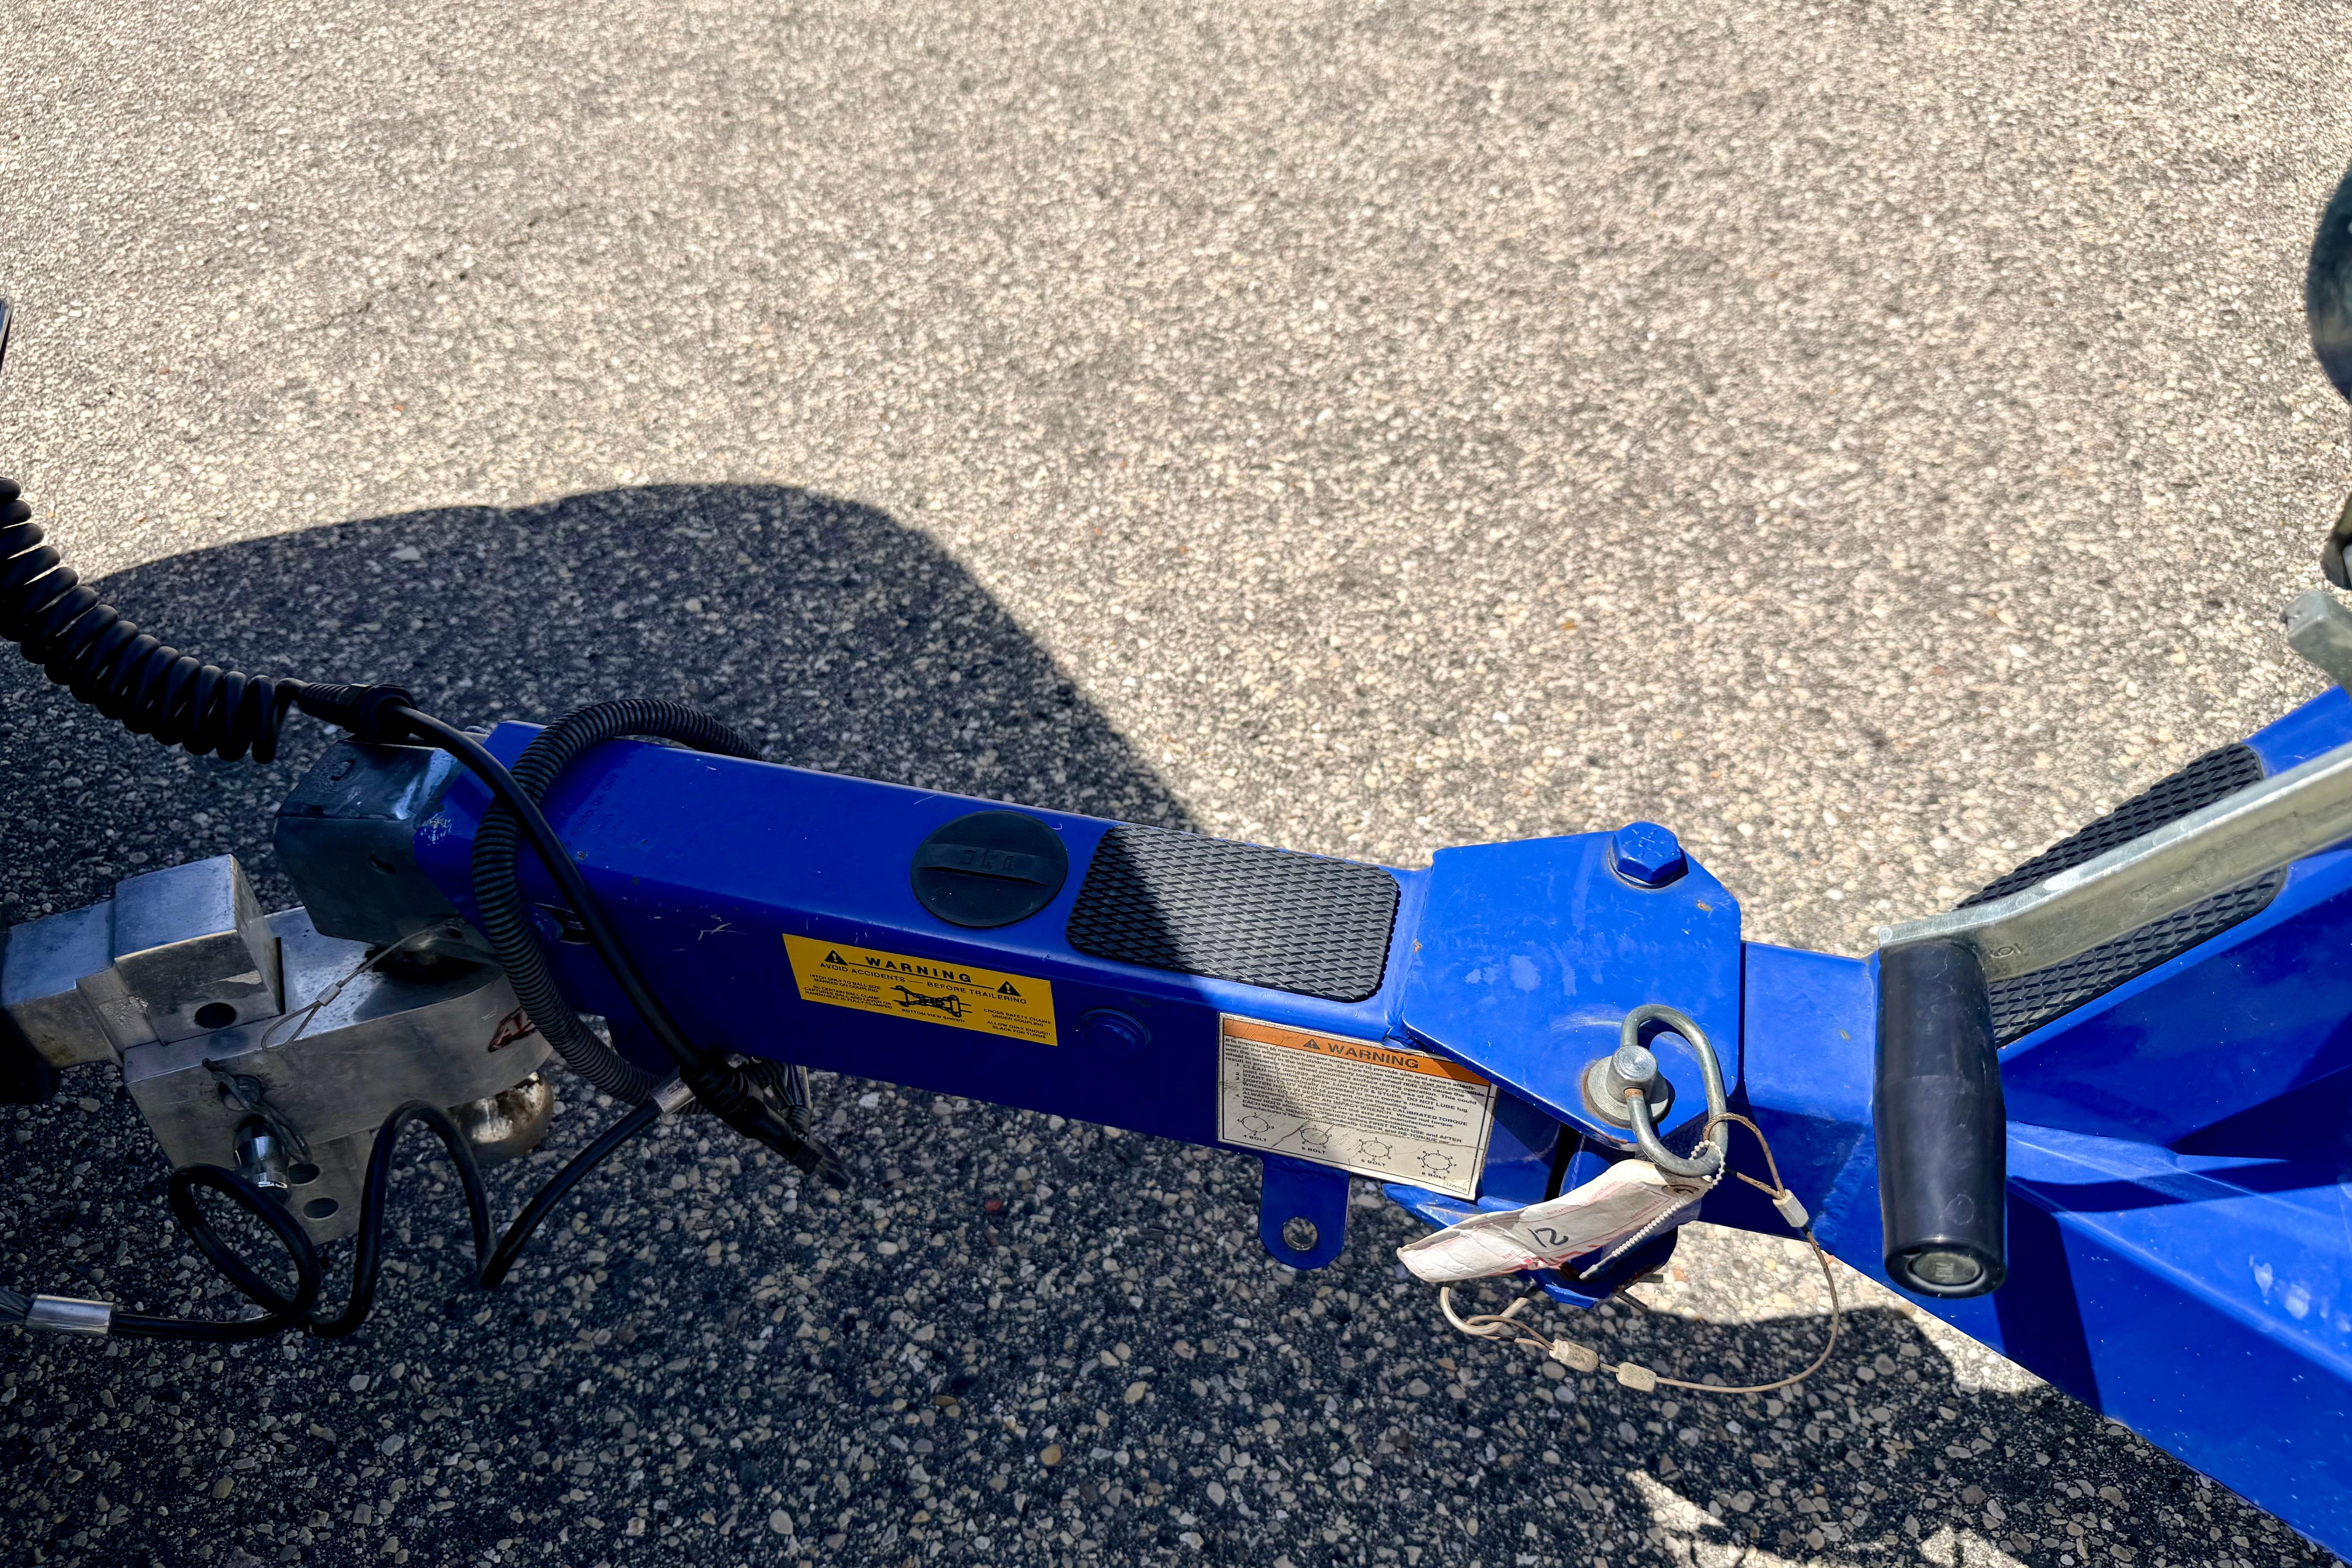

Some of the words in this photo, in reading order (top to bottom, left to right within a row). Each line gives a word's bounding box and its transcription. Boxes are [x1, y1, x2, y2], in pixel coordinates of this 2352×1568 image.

[864, 956, 971, 983] WARNING
[819, 962, 848, 972] AVOID
[850, 968, 905, 982] ACCIDENTS
[926, 981, 966, 993] BEFORE
[969, 989, 1027, 1004] TRAILERING
[1014, 1018, 1043, 1027] COUPLING
[1327, 1043, 1419, 1069] WARNING
[1374, 1067, 1398, 1075] provide
[1377, 1091, 1403, 1099] STUDS.
[1409, 1102, 1435, 1110] manual.
[1392, 1107, 1437, 1120] CALIBRATED
[1438, 1117, 1467, 1126] TORQUE
[1390, 1116, 1436, 1129] manufacturer.
[1501, 1250, 1515, 1260] DATE
